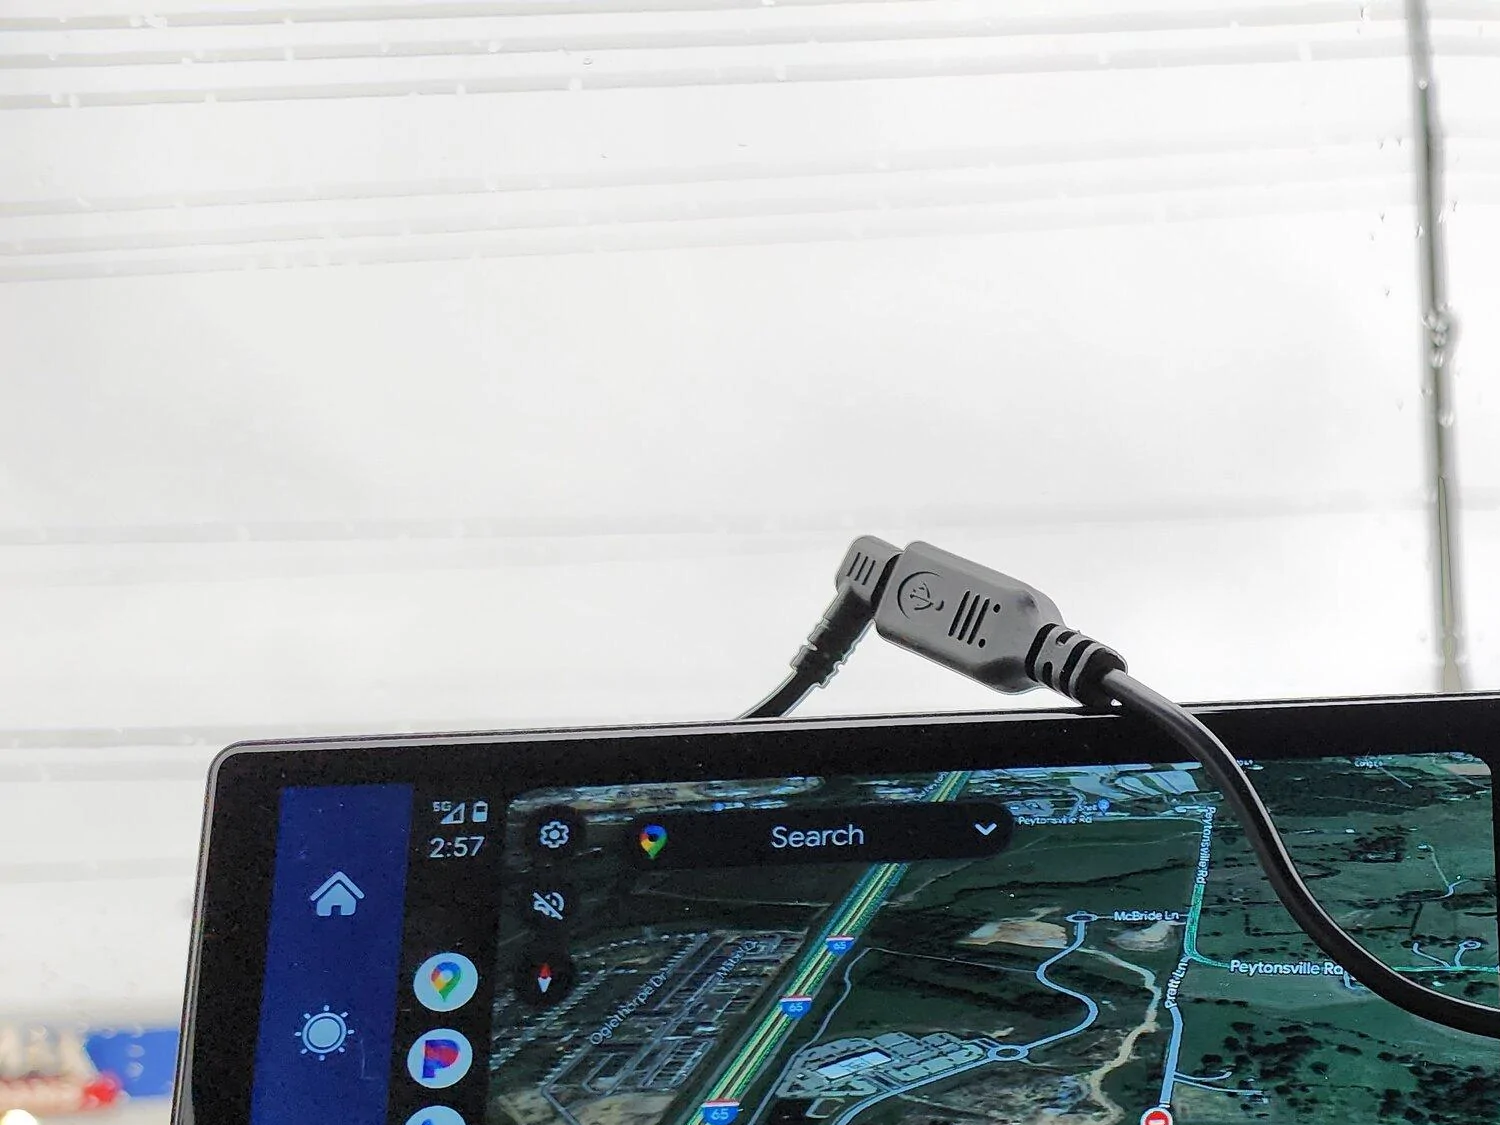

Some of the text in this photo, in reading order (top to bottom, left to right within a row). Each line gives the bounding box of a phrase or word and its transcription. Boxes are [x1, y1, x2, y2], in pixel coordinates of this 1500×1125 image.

[771, 823, 865, 849] Search
[1195, 806, 1217, 885] Peytonsville Rd
[429, 835, 486, 858] 2:57
[1113, 910, 1180, 922] McBride Ln
[833, 941, 847, 949] 65
[1230, 959, 1321, 976] Peytonsville
[1164, 962, 1188, 1009] Pratt Ln
[589, 986, 655, 1046] Oglethorpe
[788, 1002, 804, 1012] 65
[711, 1109, 729, 1120] 65
